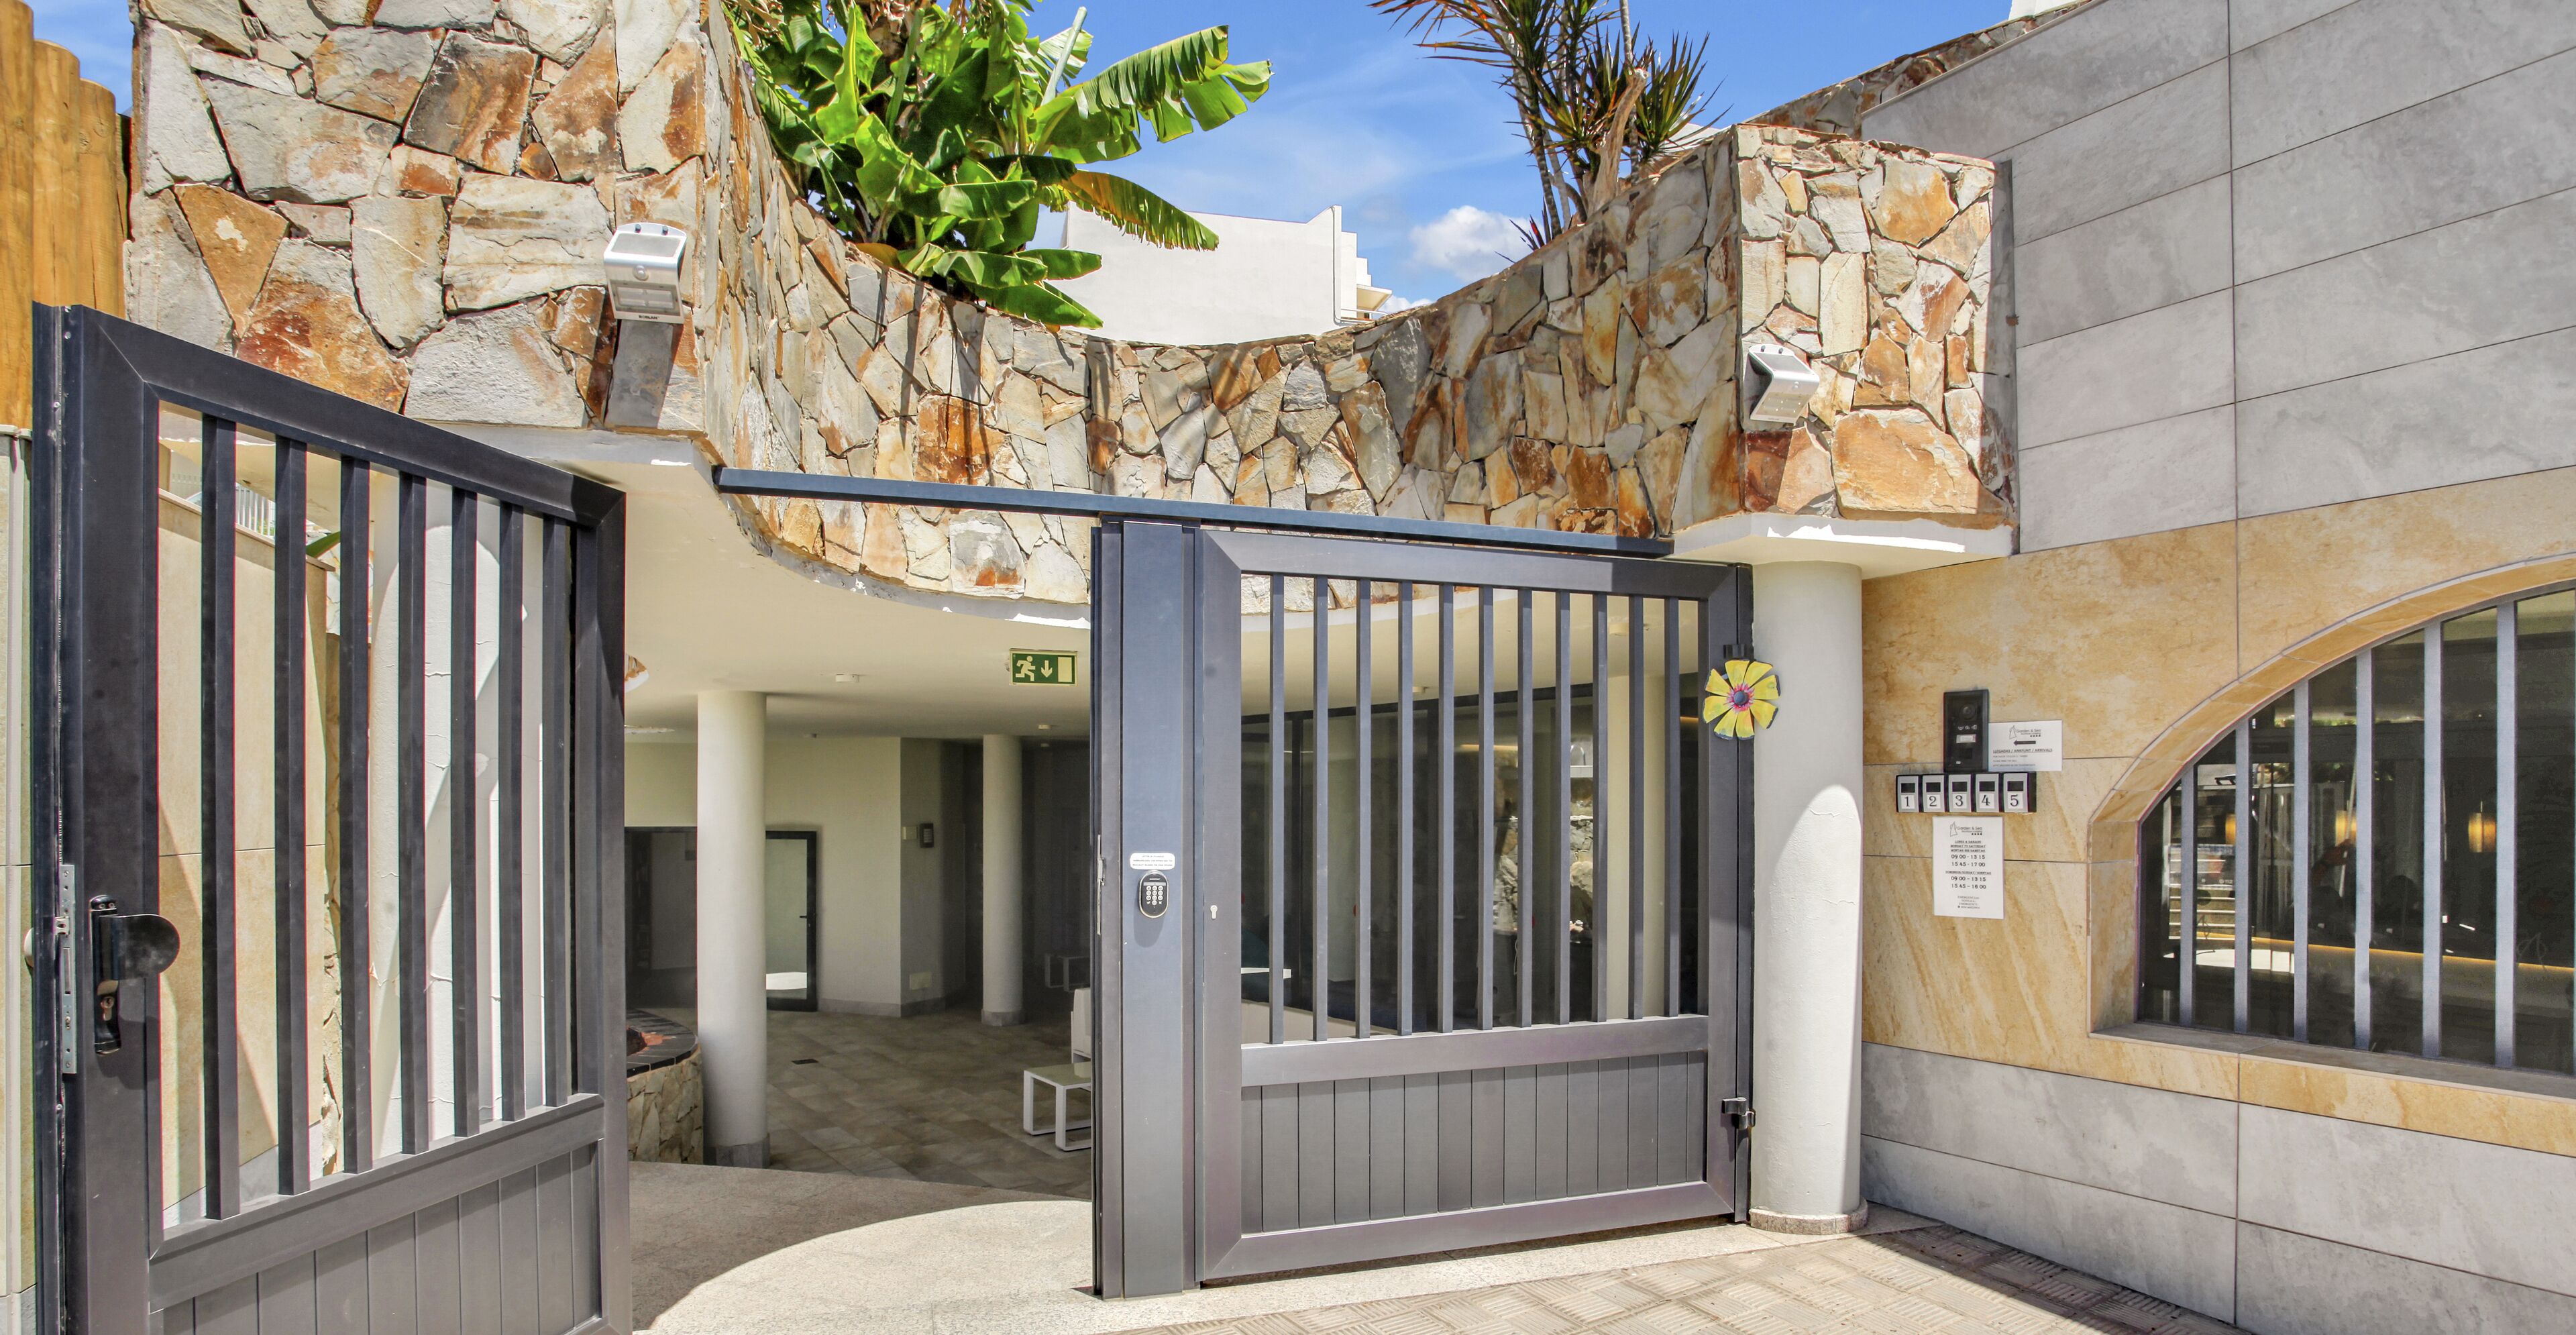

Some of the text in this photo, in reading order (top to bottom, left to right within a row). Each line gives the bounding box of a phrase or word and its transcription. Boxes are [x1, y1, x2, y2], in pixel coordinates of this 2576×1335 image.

[1904, 796, 1910, 806] 1
[1929, 796, 1937, 806] 2
[1955, 795, 1964, 806] 3
[1982, 794, 1990, 806] 4
[2010, 794, 2019, 806] 5
